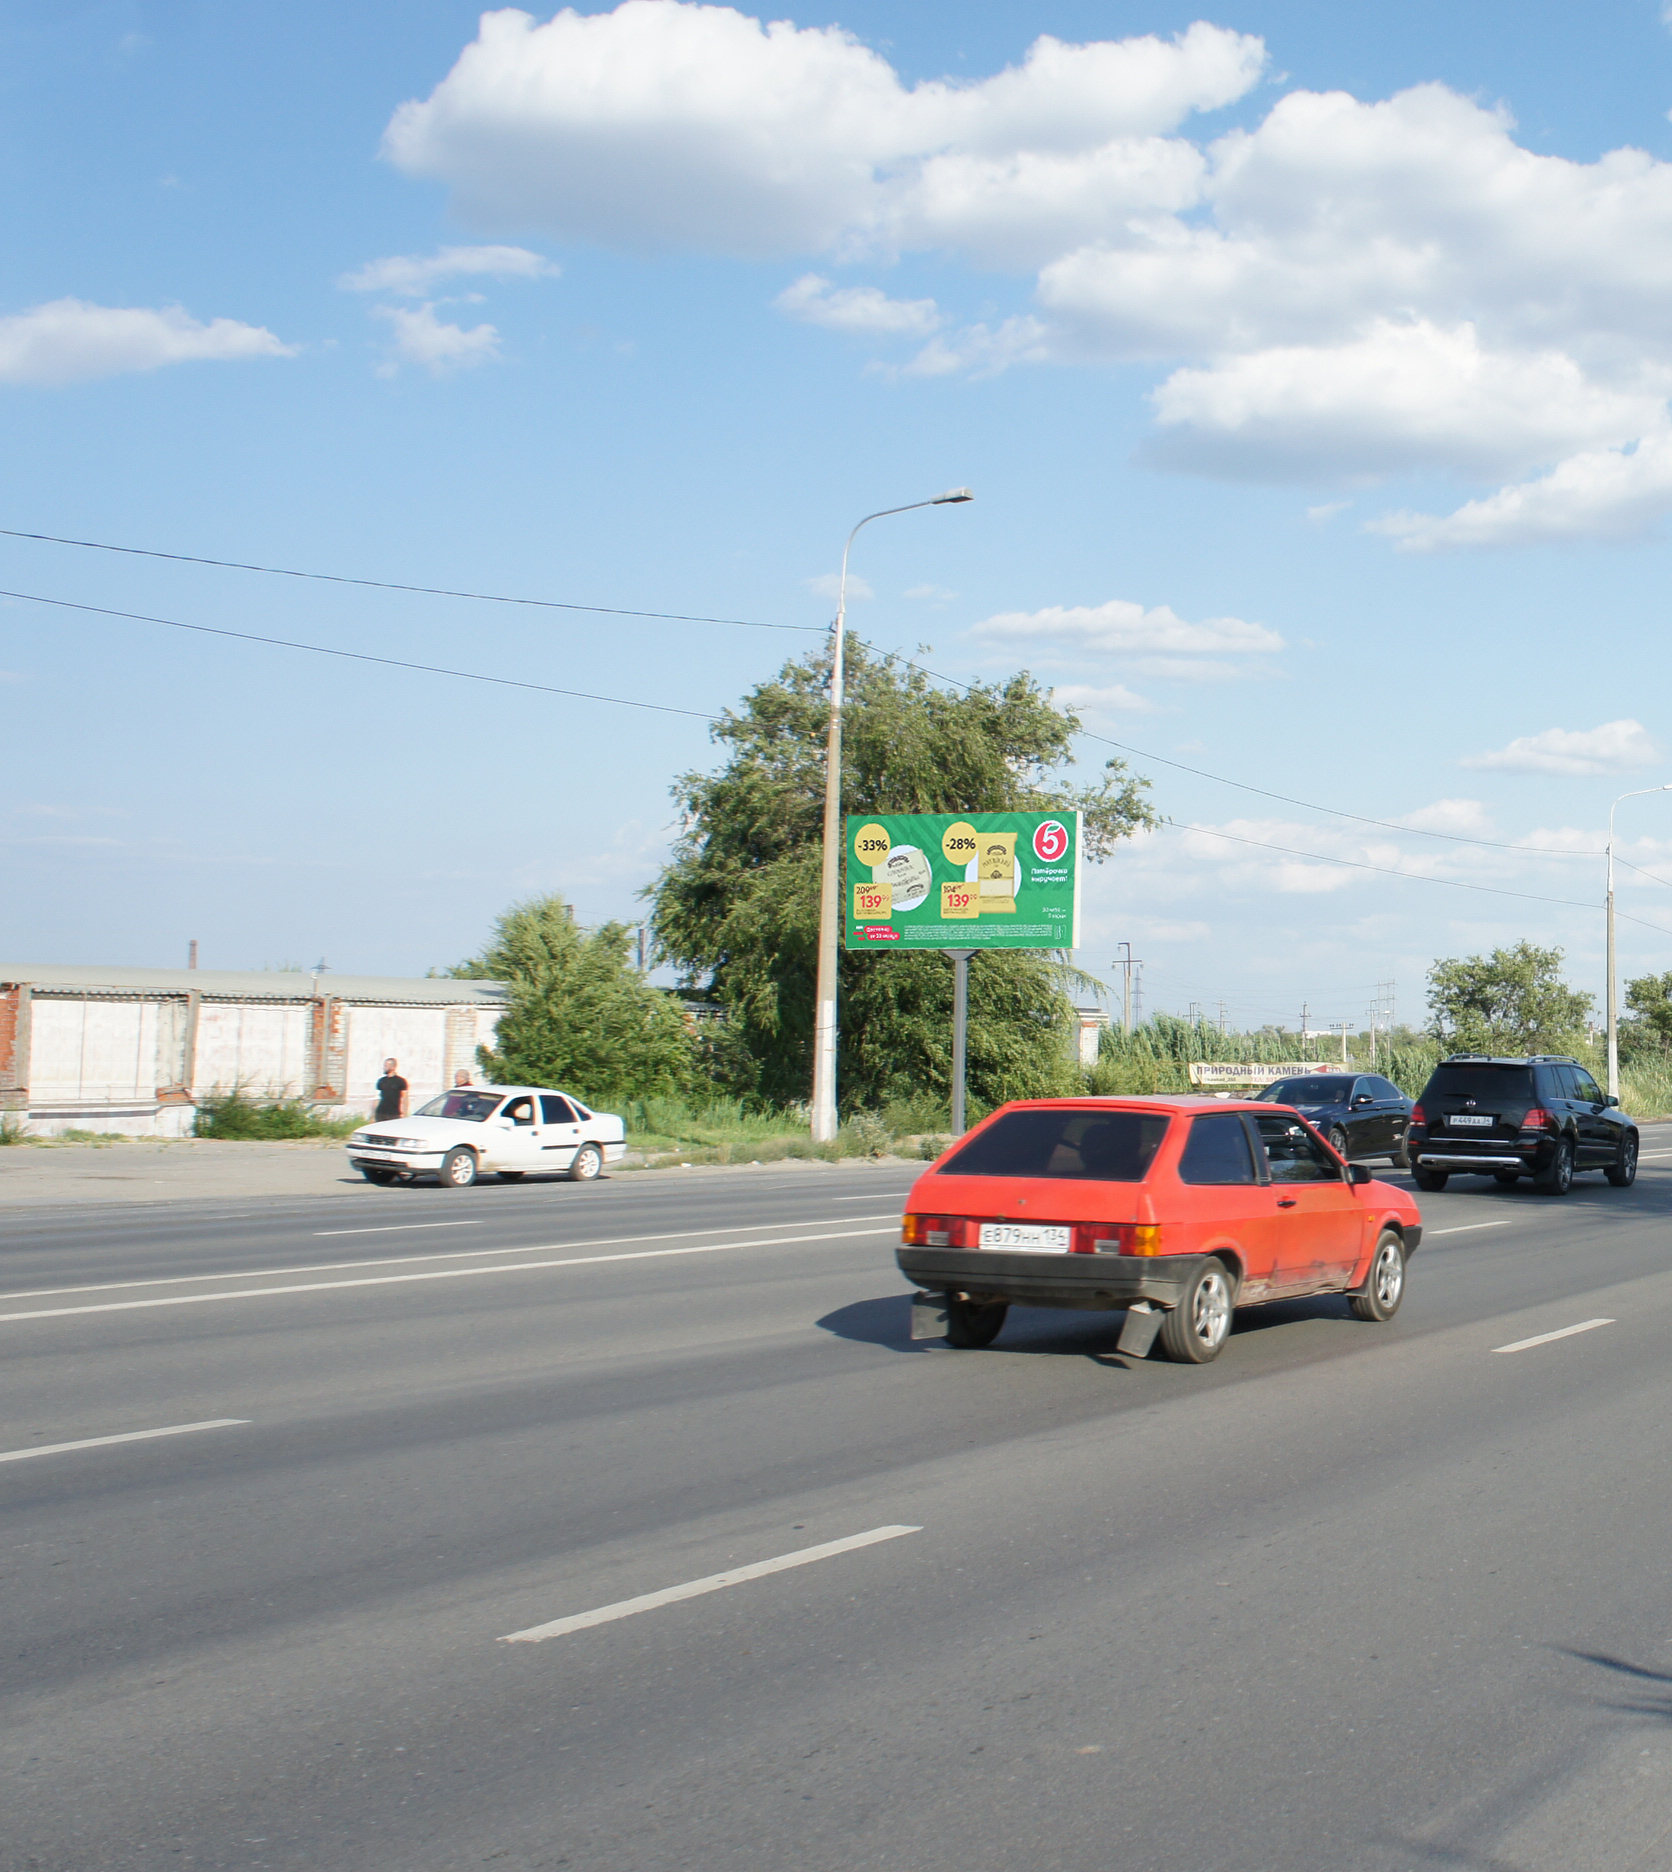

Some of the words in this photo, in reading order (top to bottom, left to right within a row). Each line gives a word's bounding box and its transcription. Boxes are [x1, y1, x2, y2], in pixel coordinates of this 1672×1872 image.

[858, 839, 888, 851] -33%
[946, 838, 976, 850] -28%
[860, 895, 882, 908] 139
[947, 894, 970, 907] 139
[1268, 1066, 1311, 1076] КАМЕНЬ
[983, 1227, 1039, 1243] Е879НН
[1043, 1228, 1067, 1241] 134
